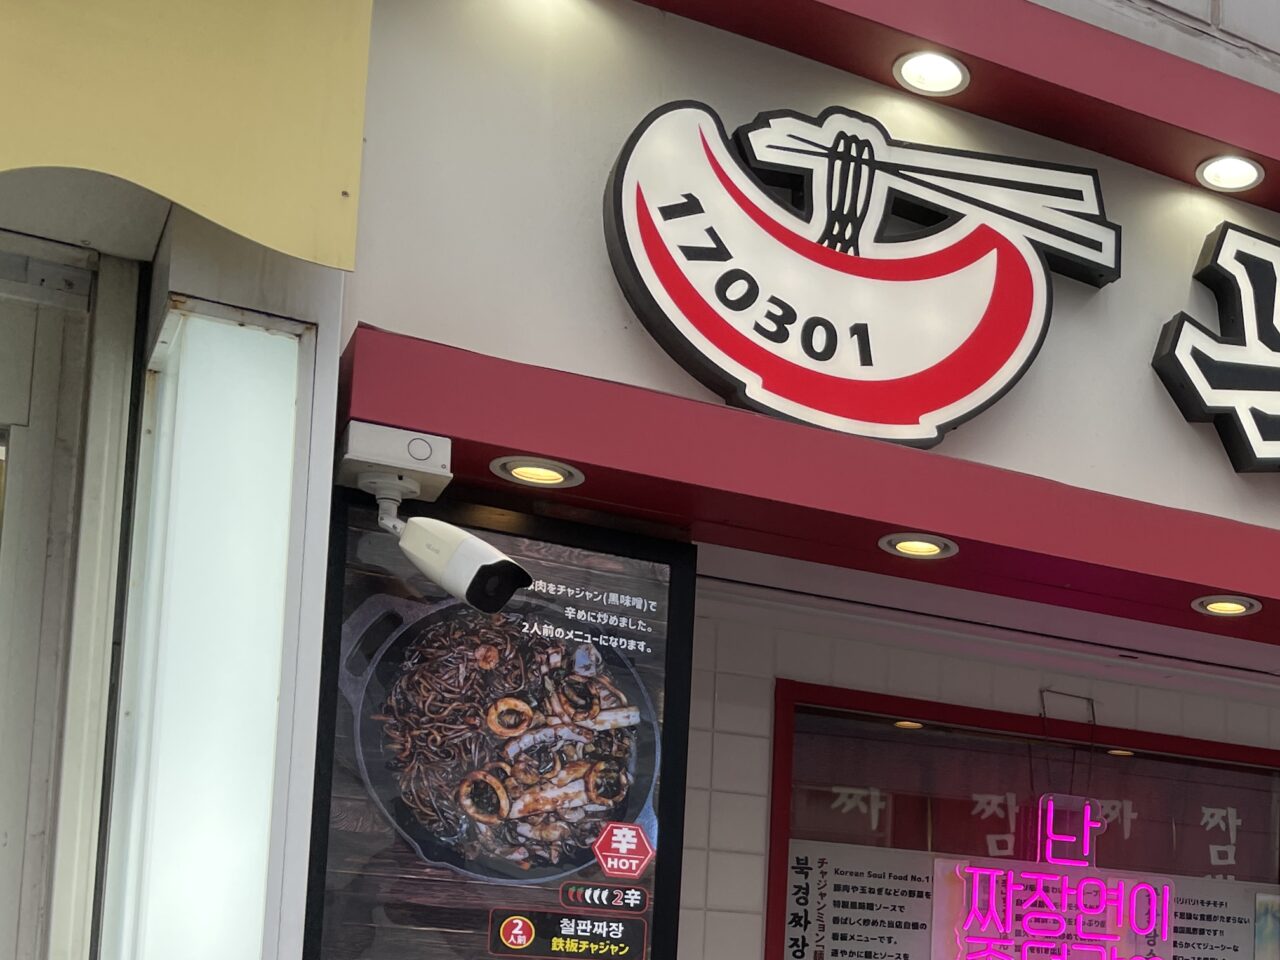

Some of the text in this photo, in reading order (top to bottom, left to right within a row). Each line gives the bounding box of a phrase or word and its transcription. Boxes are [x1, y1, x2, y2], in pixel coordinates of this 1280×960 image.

[657, 192, 874, 367] 170301
[564, 606, 653, 633] 辛めに炒めました。
[521, 622, 652, 653] 2人前のメニューになります。
[611, 828, 637, 854] 辛
[1046, 799, 1101, 867] 난
[607, 857, 639, 871] HOT
[834, 868, 865, 878] Korean
[867, 871, 886, 880] Soul
[888, 873, 908, 882] Food
[612, 888, 641, 907] 2辛
[560, 918, 624, 938] 철판짜장
[551, 937, 630, 956] 鉄板チャジャン
